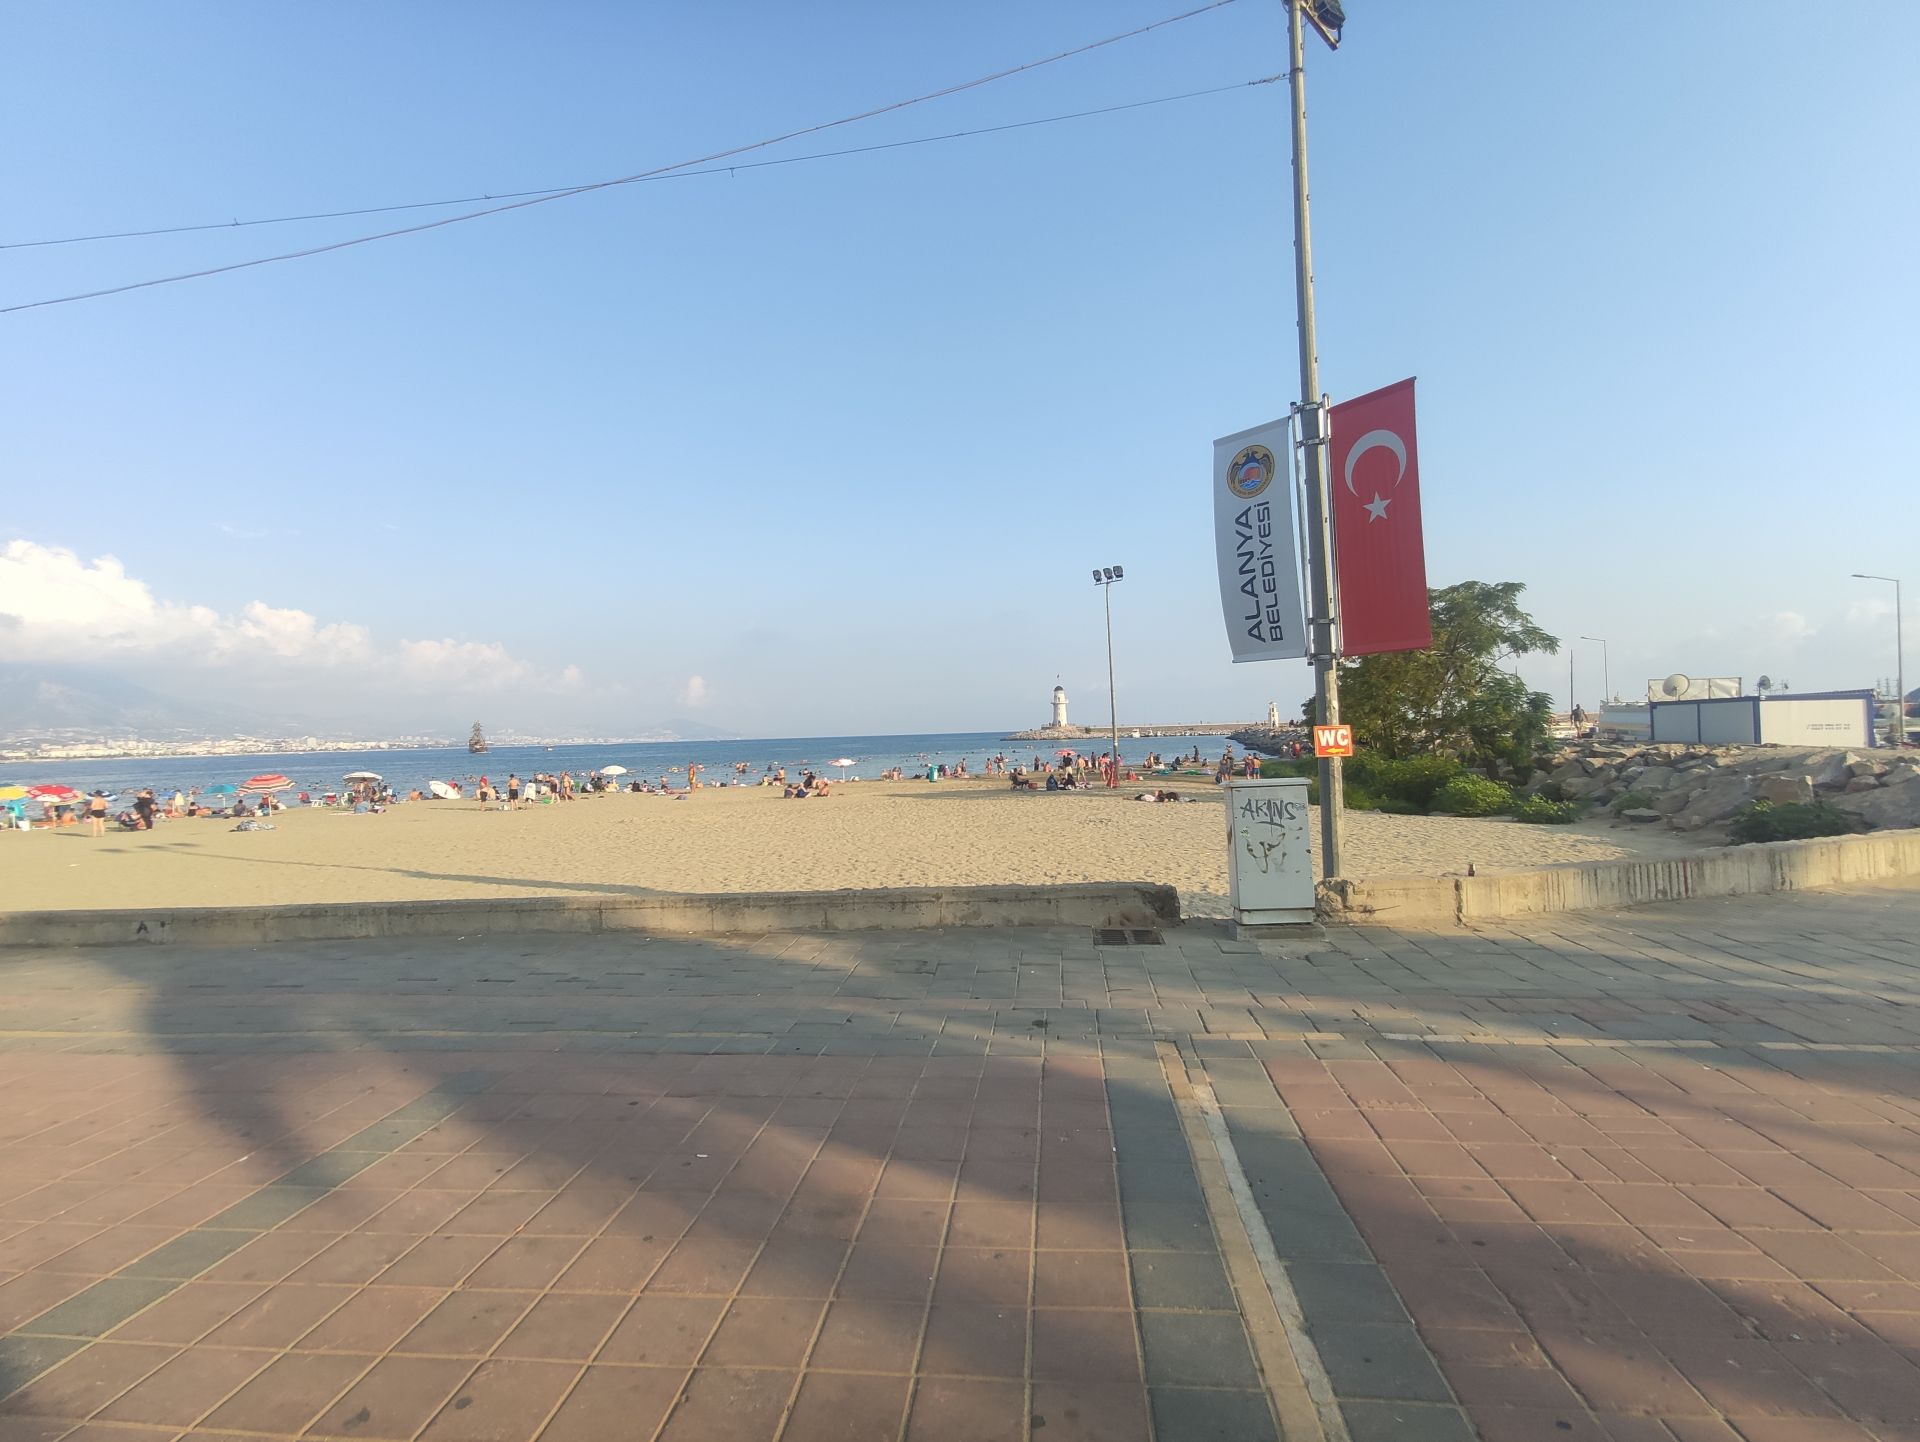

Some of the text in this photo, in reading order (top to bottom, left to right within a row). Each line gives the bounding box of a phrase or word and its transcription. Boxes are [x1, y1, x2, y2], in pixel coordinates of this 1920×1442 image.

[1235, 505, 1266, 643] ALANYA
[1253, 500, 1284, 642] BELEDİYESİ
[1317, 728, 1349, 747] WC
